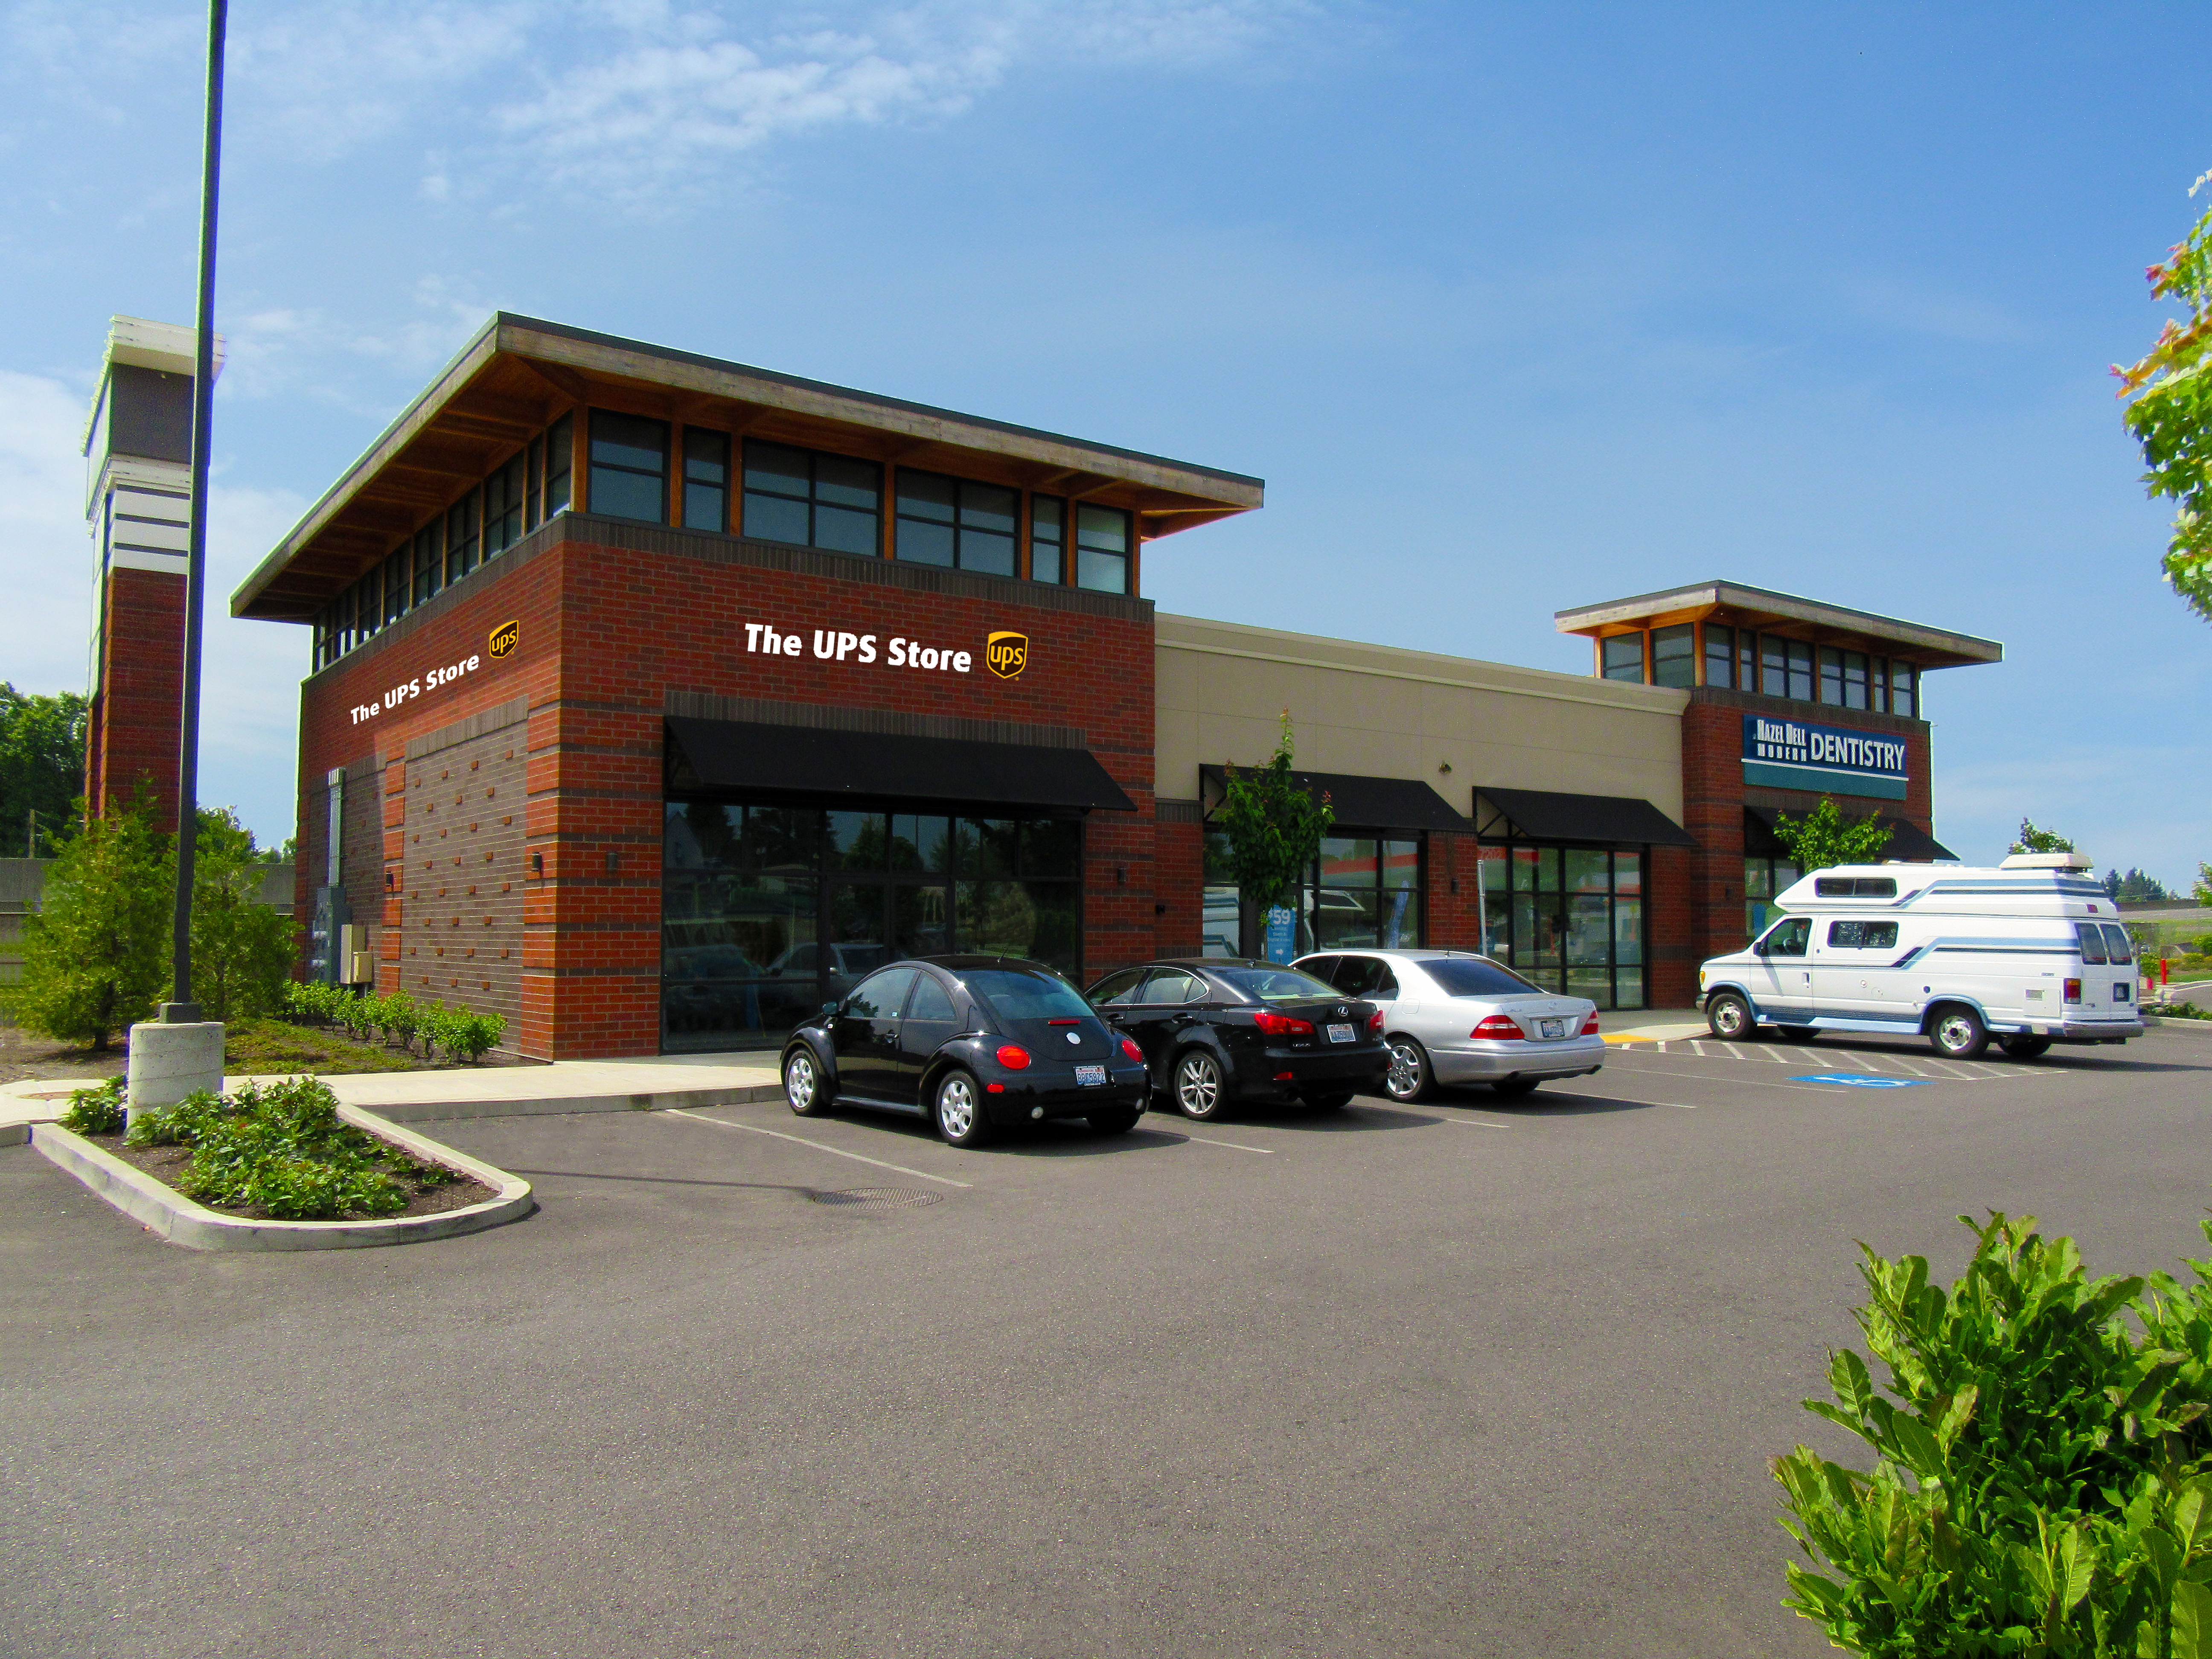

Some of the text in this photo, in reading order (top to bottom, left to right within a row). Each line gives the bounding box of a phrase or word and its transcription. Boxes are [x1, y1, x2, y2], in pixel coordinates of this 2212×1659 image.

[492, 630, 516, 654] ups
[745, 623, 971, 672] The UPS Store
[990, 646, 1024, 670] ups
[351, 655, 479, 725] The UPS Store
[1810, 733, 1905, 770] DENTISTRY
